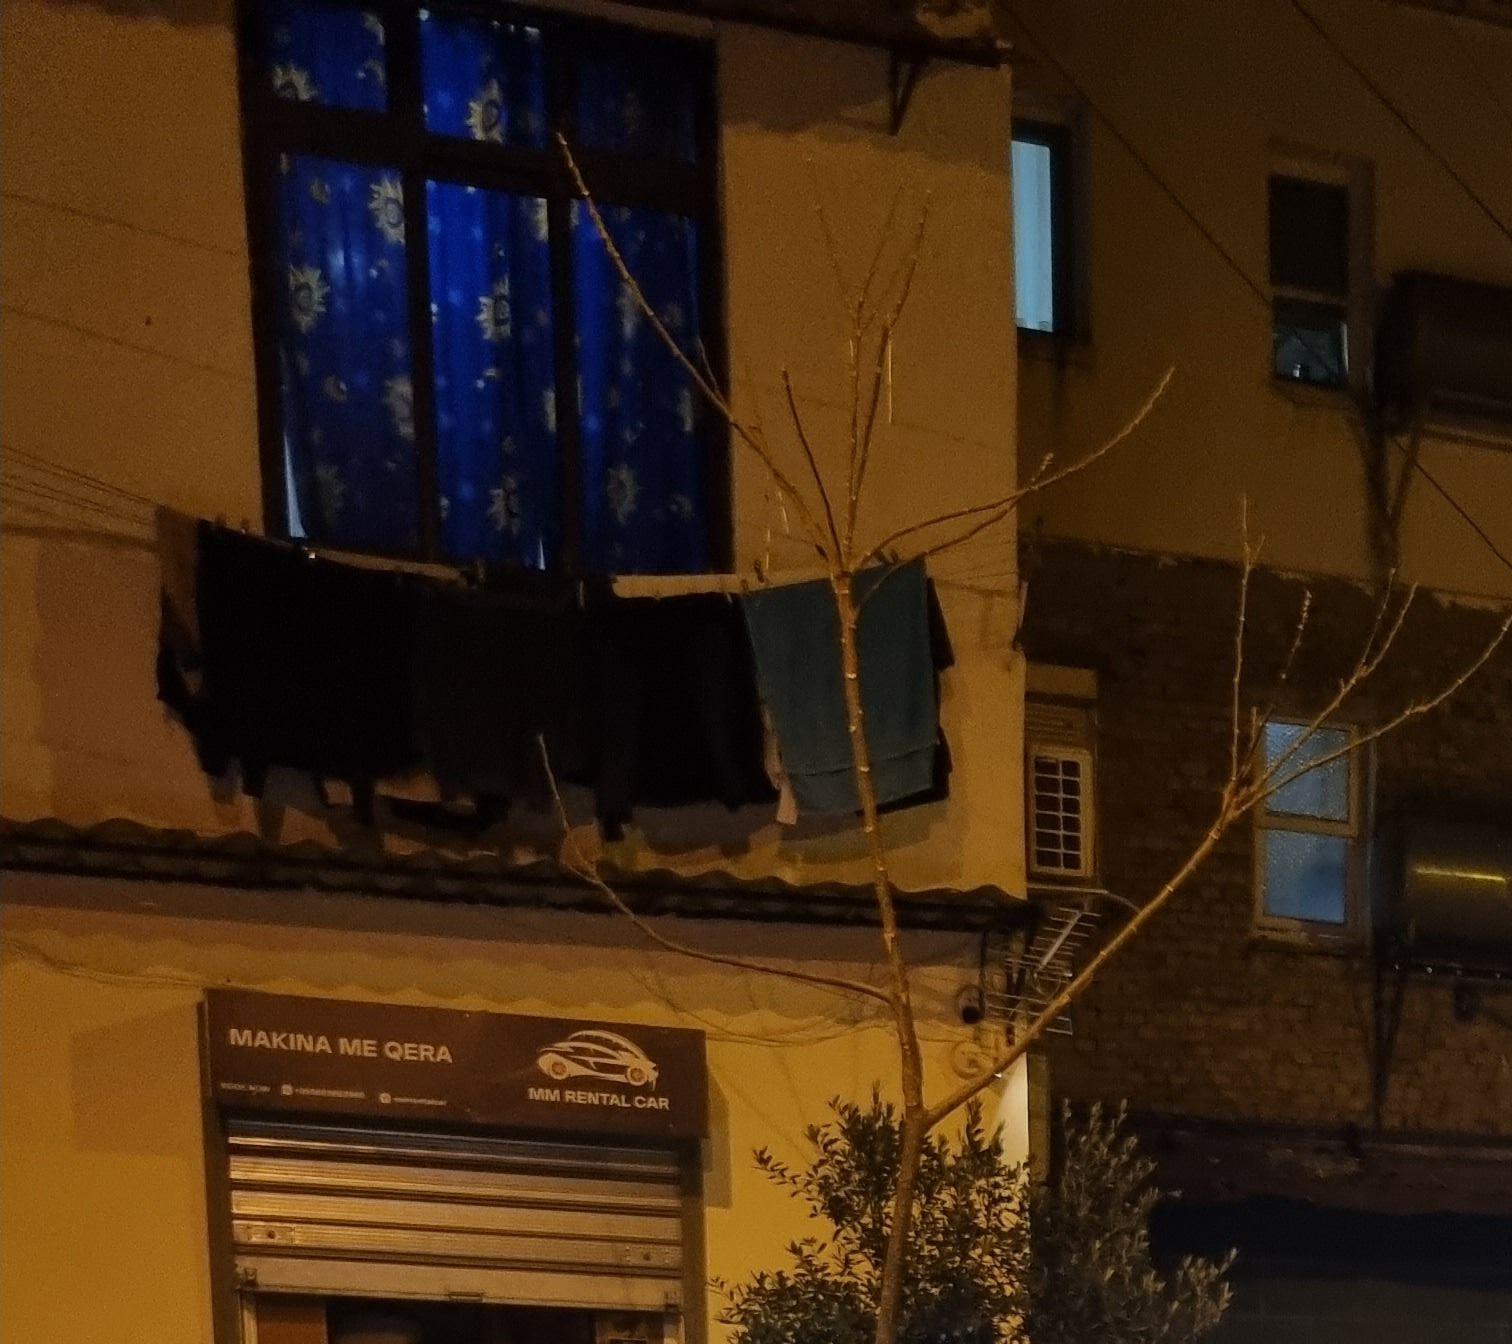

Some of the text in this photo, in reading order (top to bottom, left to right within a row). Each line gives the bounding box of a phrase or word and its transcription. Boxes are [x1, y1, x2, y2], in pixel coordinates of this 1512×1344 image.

[229, 1028, 453, 1064] MAKINA ME QERA
[528, 1087, 670, 1110] MM RENTAL CAR
